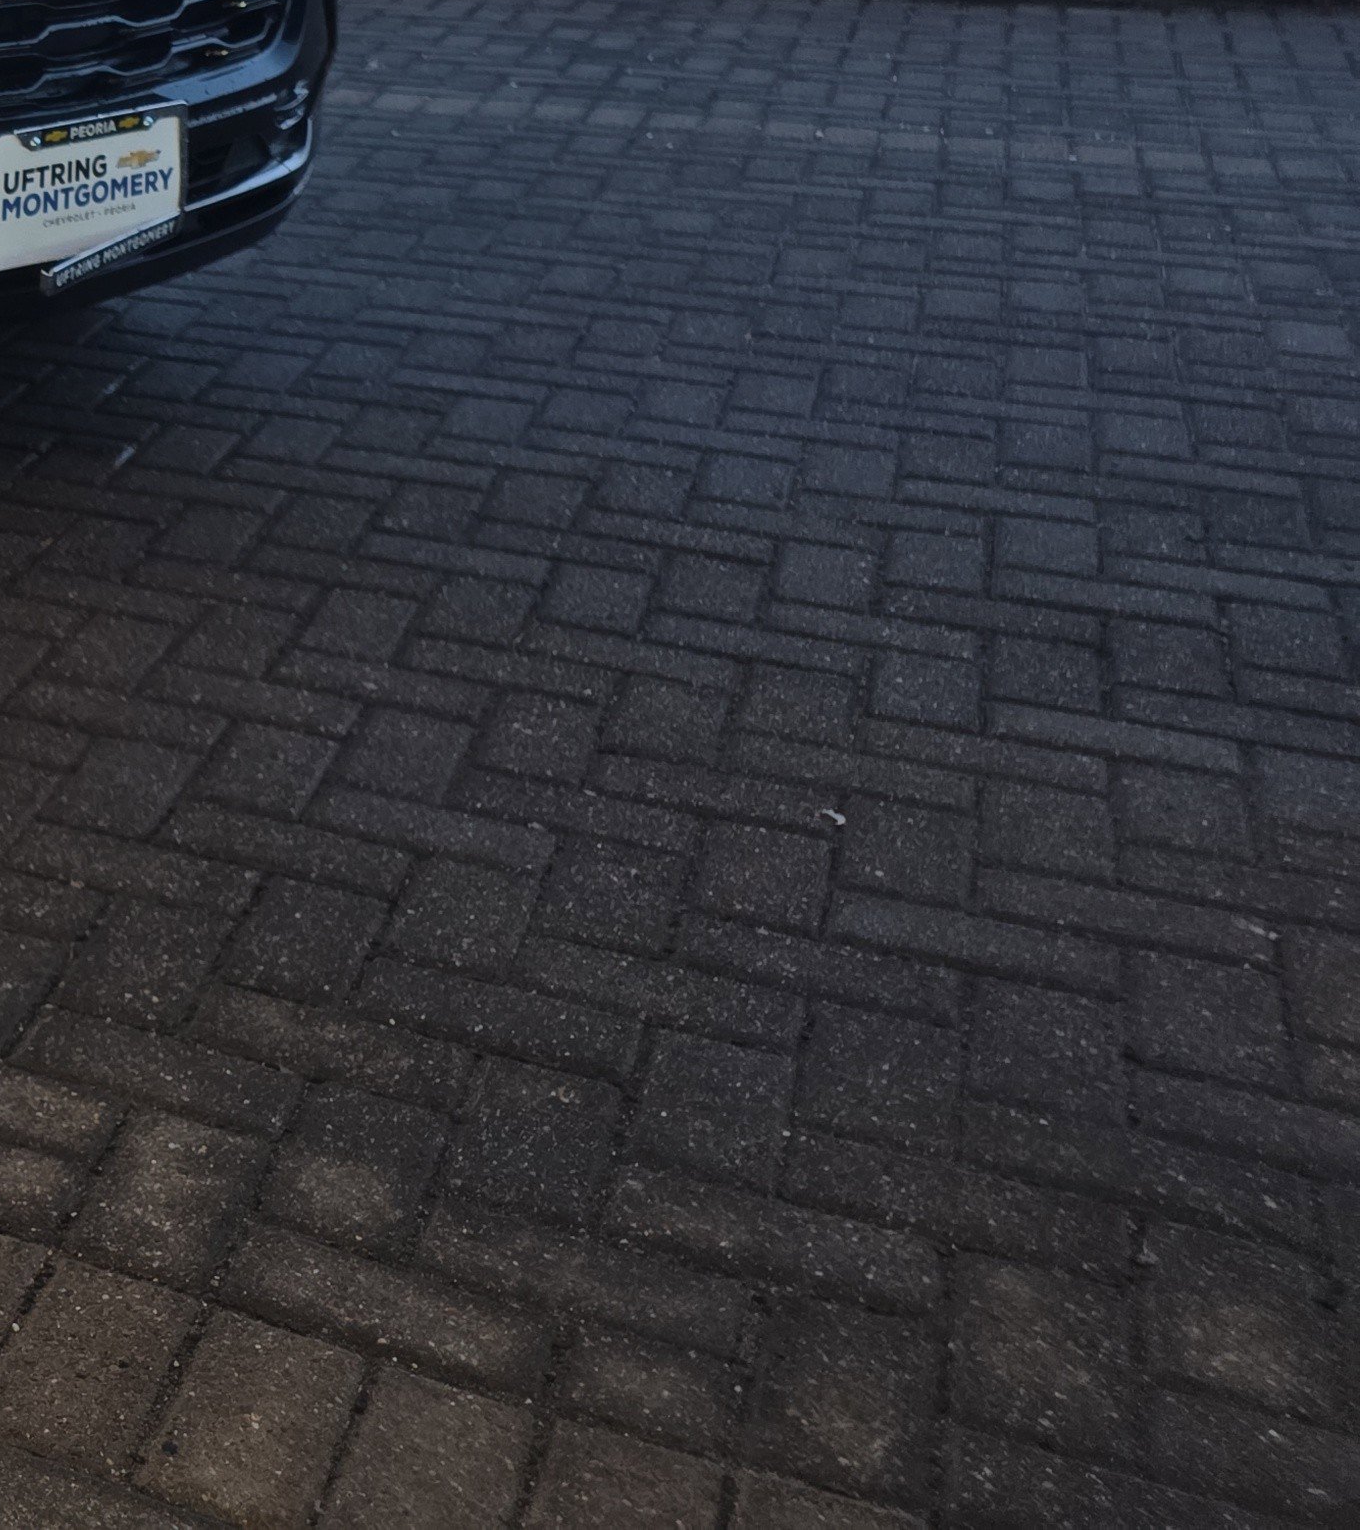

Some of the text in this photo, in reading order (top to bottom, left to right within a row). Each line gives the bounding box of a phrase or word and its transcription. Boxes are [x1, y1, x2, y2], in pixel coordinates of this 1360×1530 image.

[70, 119, 117, 140] PEORIA
[2, 167, 173, 221] MONTGOMERY
[4, 155, 107, 195] UFTRING
[56, 220, 175, 288] UFTRING MONTGOMERY
